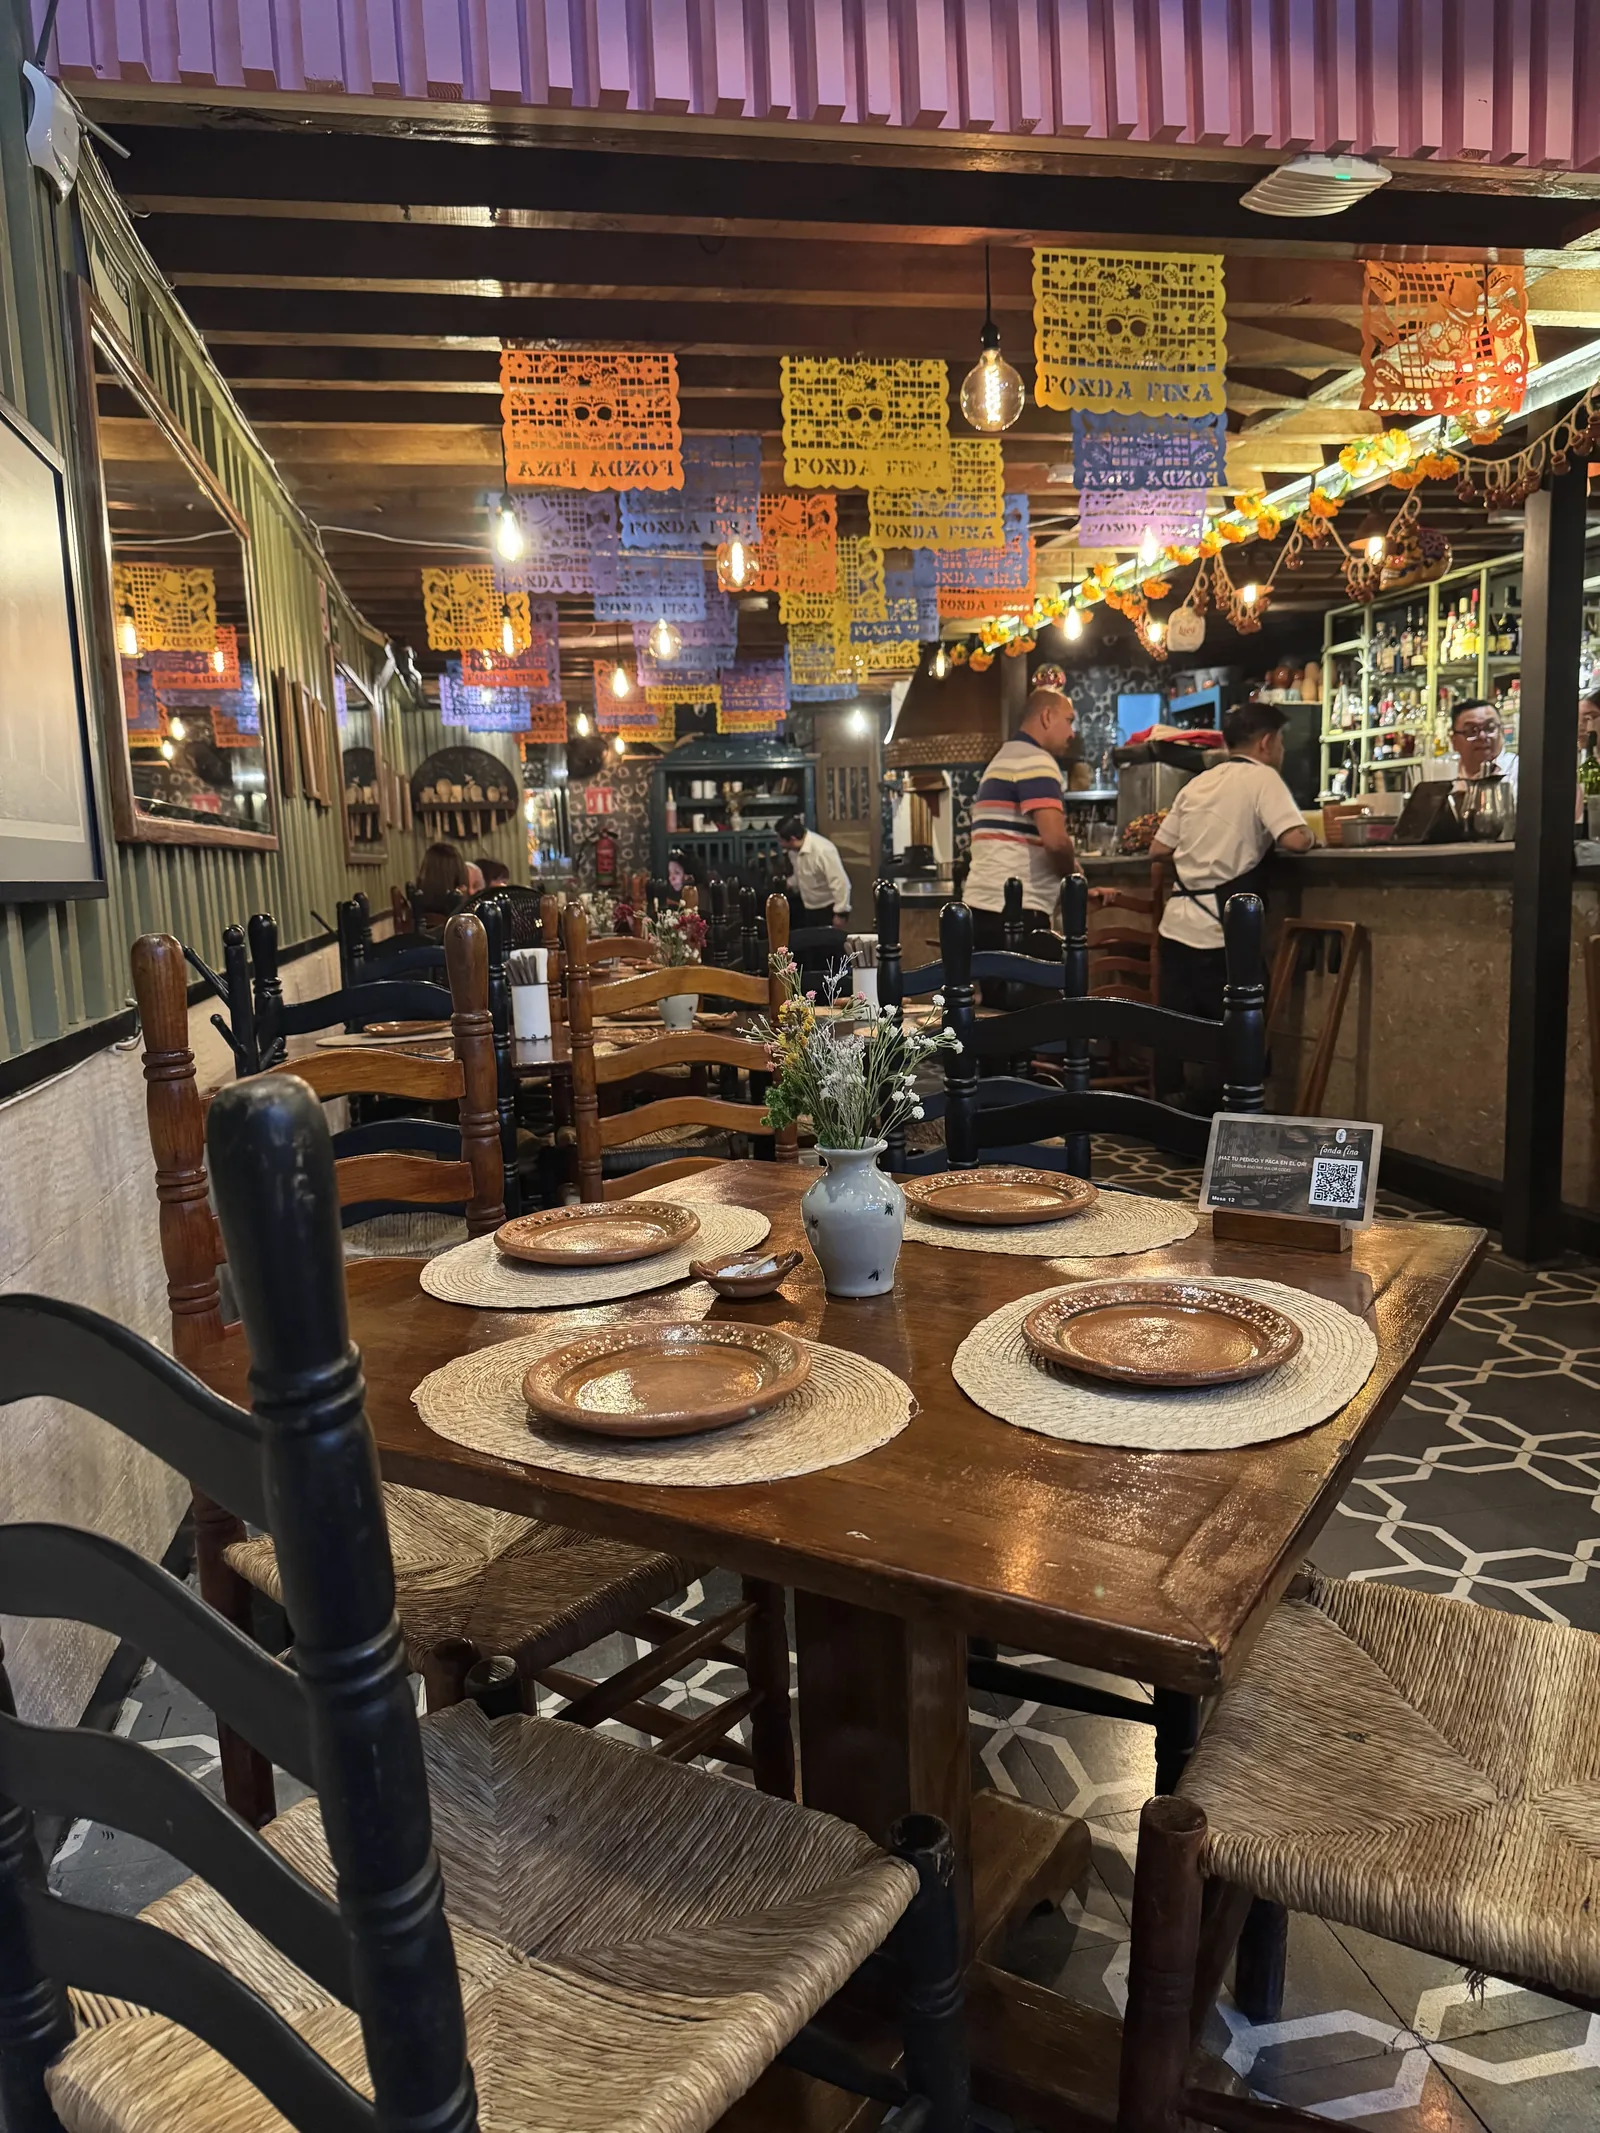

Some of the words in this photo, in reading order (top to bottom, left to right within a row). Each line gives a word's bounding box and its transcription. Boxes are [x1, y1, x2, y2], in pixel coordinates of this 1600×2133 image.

[1044, 374, 1133, 399] FONDA
[1147, 381, 1213, 402] FINA
[793, 458, 875, 476] FONDA
[630, 519, 701, 536] FONDA
[874, 523, 939, 539] FONDA
[949, 525, 996, 540] FINA
[600, 603, 654, 615] FONDA
[662, 603, 699, 615] FINA
[940, 600, 985, 611] FONDA
[434, 636, 486, 647] FONDA
[886, 656, 915, 666] FINA
